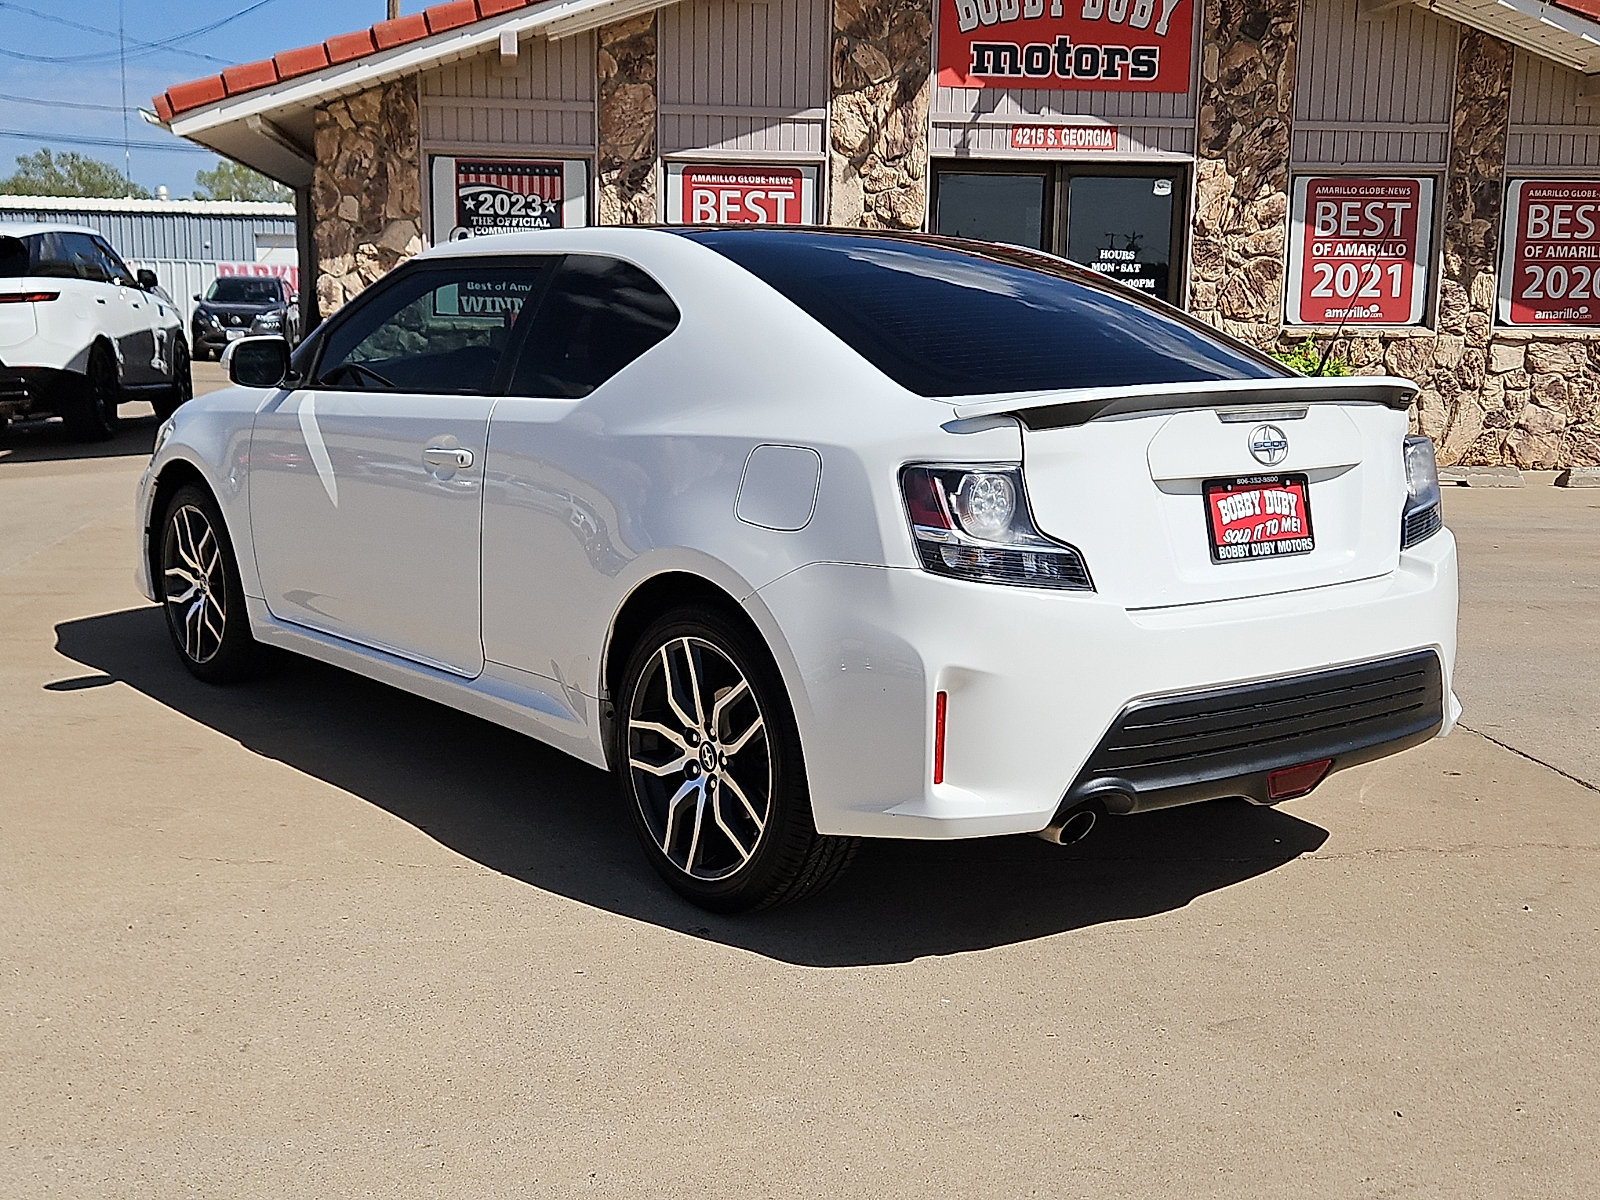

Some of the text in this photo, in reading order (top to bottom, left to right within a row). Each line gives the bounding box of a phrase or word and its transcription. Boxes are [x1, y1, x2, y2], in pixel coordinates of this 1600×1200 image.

[970, 35, 1160, 81] motors
[1015, 127, 1113, 147] 4215 S. GEORGIA
[691, 174, 794, 185] AMARILLO GLOBE-NEWS
[1315, 186, 1411, 196] AMARILLO GLOBE-NEWS
[1528, 189, 1600, 198] AMARILLO GLOBE-
[478, 193, 542, 217] 2023
[692, 189, 795, 223] BEST
[470, 216, 551, 227] THE OFFICIAL
[1314, 201, 1412, 237] BEST
[1526, 204, 1600, 239] BES
[1100, 249, 1136, 260] HOURS
[1312, 243, 1407, 257] OF AMARILLO
[1524, 245, 1600, 259] OF AMARIL
[466, 281, 492, 291] Best
[495, 281, 506, 291] of
[1310, 262, 1403, 298] 2021
[1216, 489, 1298, 526] BOBBY DUBY
[1222, 528, 1252, 544] SOLD
[1253, 522, 1265, 541] IT
[1265, 518, 1279, 537] TO
[1218, 537, 1314, 559] BOBBY DUBY MOTORS
